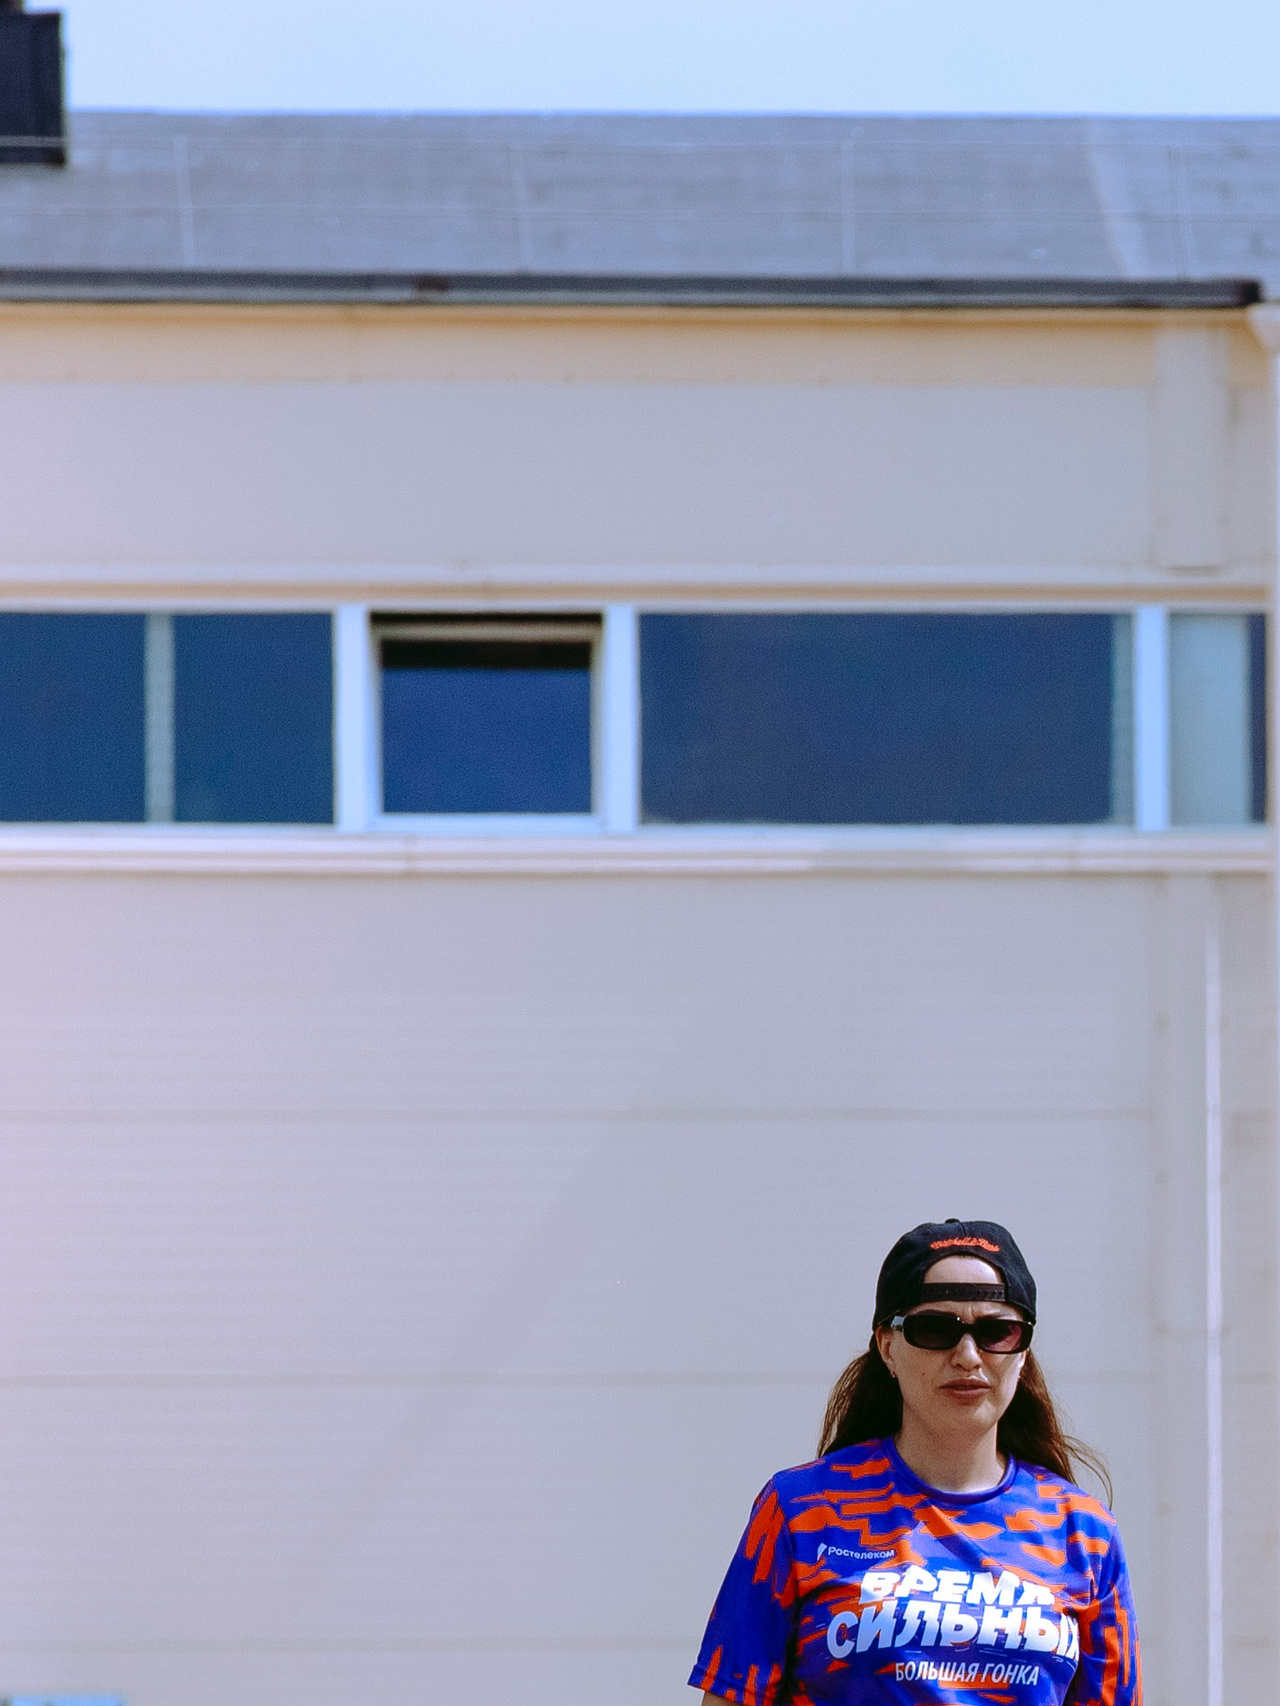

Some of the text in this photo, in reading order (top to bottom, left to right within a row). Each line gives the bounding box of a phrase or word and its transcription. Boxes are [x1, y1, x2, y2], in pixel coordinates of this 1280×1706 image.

[828, 1546, 895, 1559] Ростелеком
[895, 1661, 1040, 1686] БОЛЬШАЯ ГОНКА
